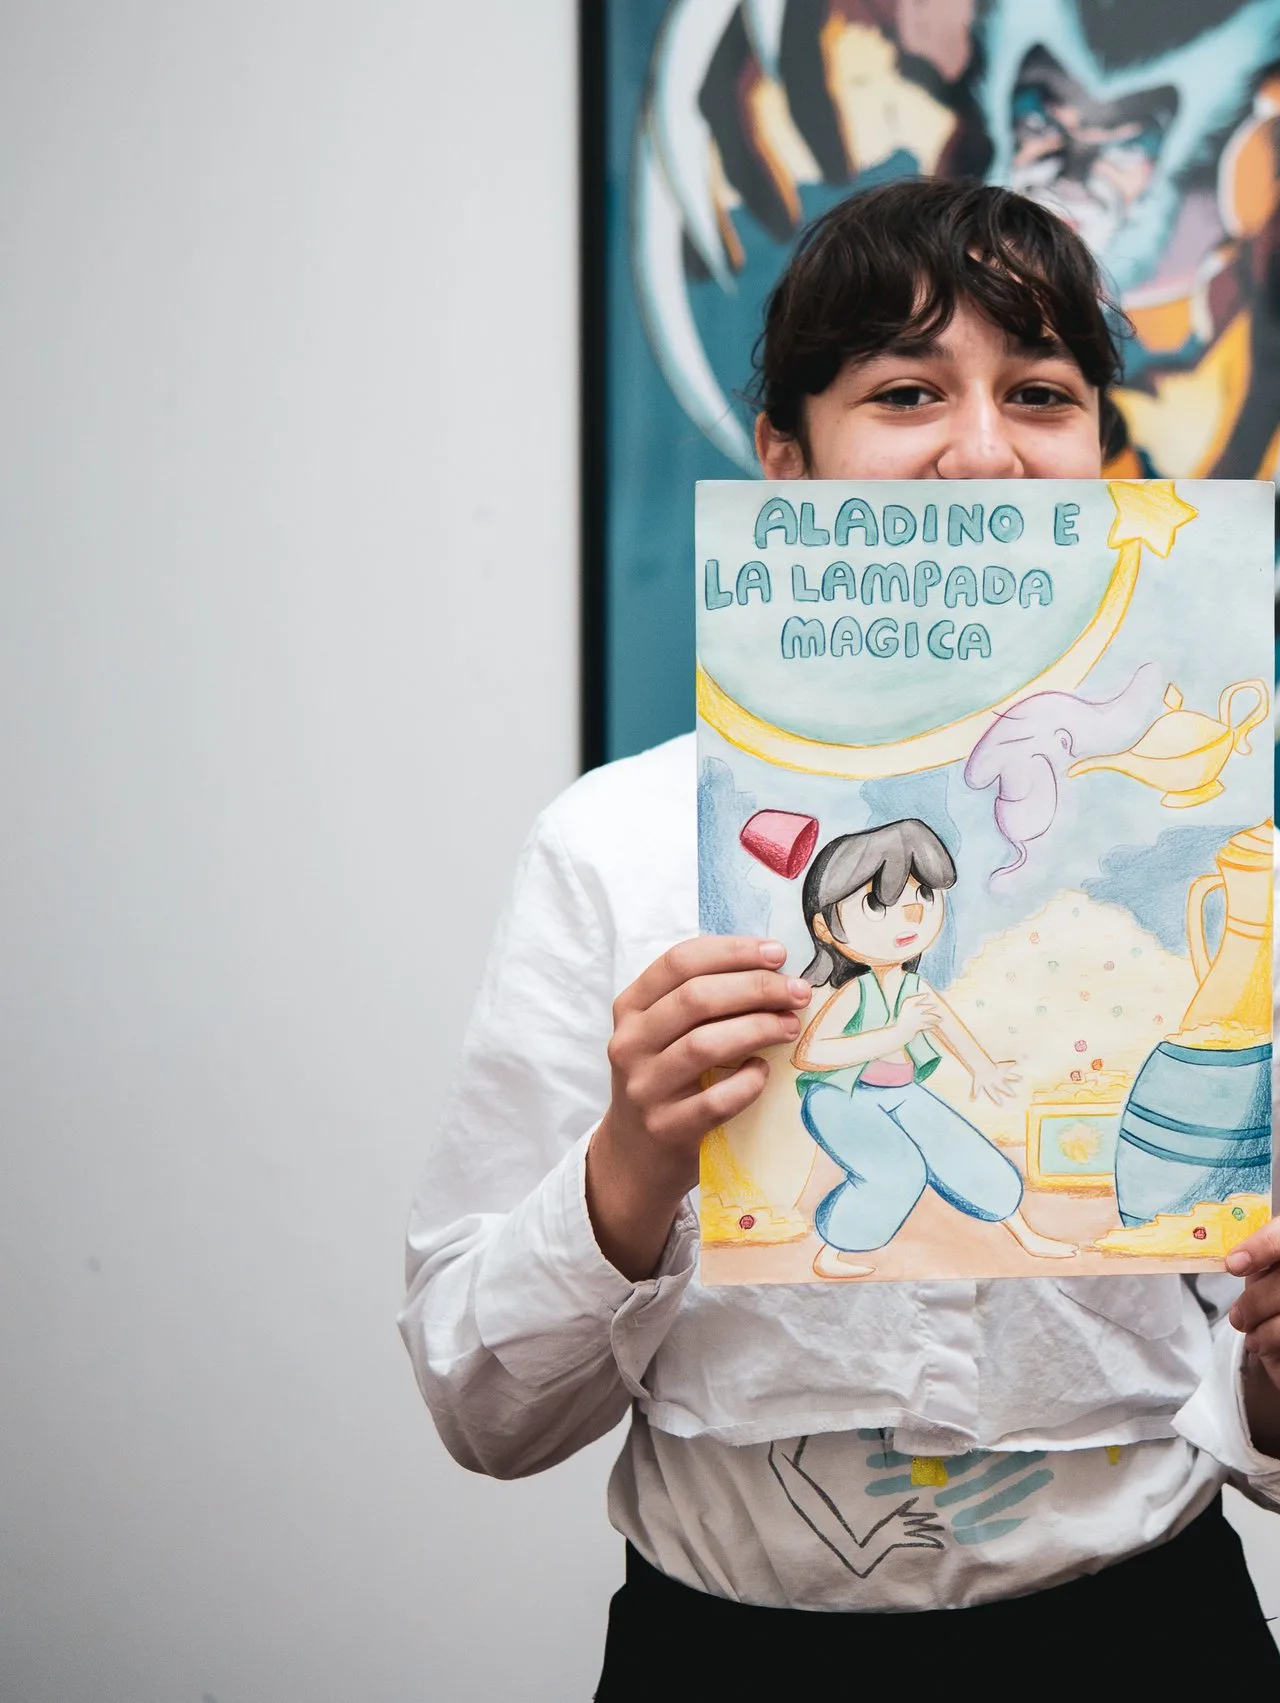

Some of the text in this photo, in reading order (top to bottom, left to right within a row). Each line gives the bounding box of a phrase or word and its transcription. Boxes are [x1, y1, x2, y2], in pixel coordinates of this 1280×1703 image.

[754, 497, 1080, 549] ALADINO E
[704, 558, 1053, 610] LA LAMPADA
[781, 616, 992, 660] MAGICA
